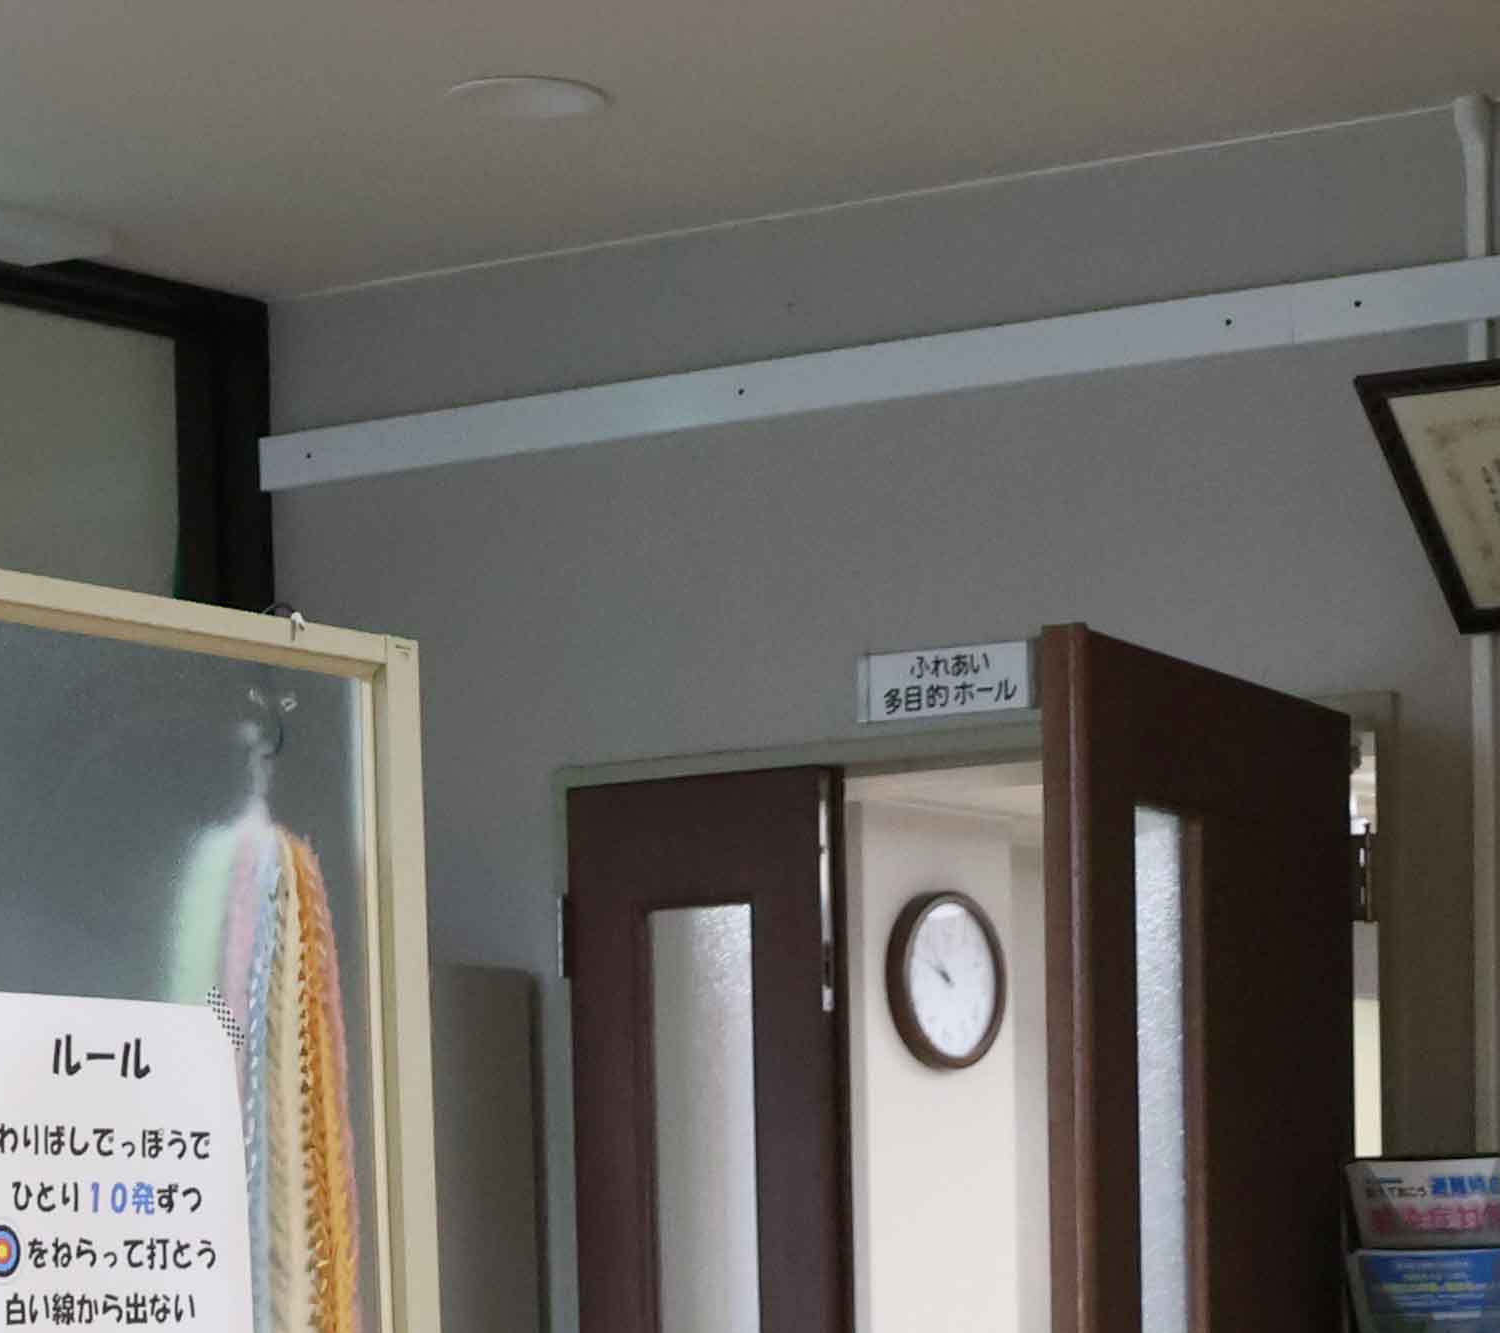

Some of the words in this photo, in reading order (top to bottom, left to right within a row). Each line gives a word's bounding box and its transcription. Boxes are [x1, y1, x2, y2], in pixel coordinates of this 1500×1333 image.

[909, 652, 991, 680] ふれあい
[883, 681, 1018, 716] 多目的ホール
[51, 1033, 152, 1081] ルール
[11, 1181, 203, 1217] ひとり10発ずつ
[26, 1235, 219, 1273] をねらって打とう
[4, 1292, 197, 1328] 白い線から出ない
